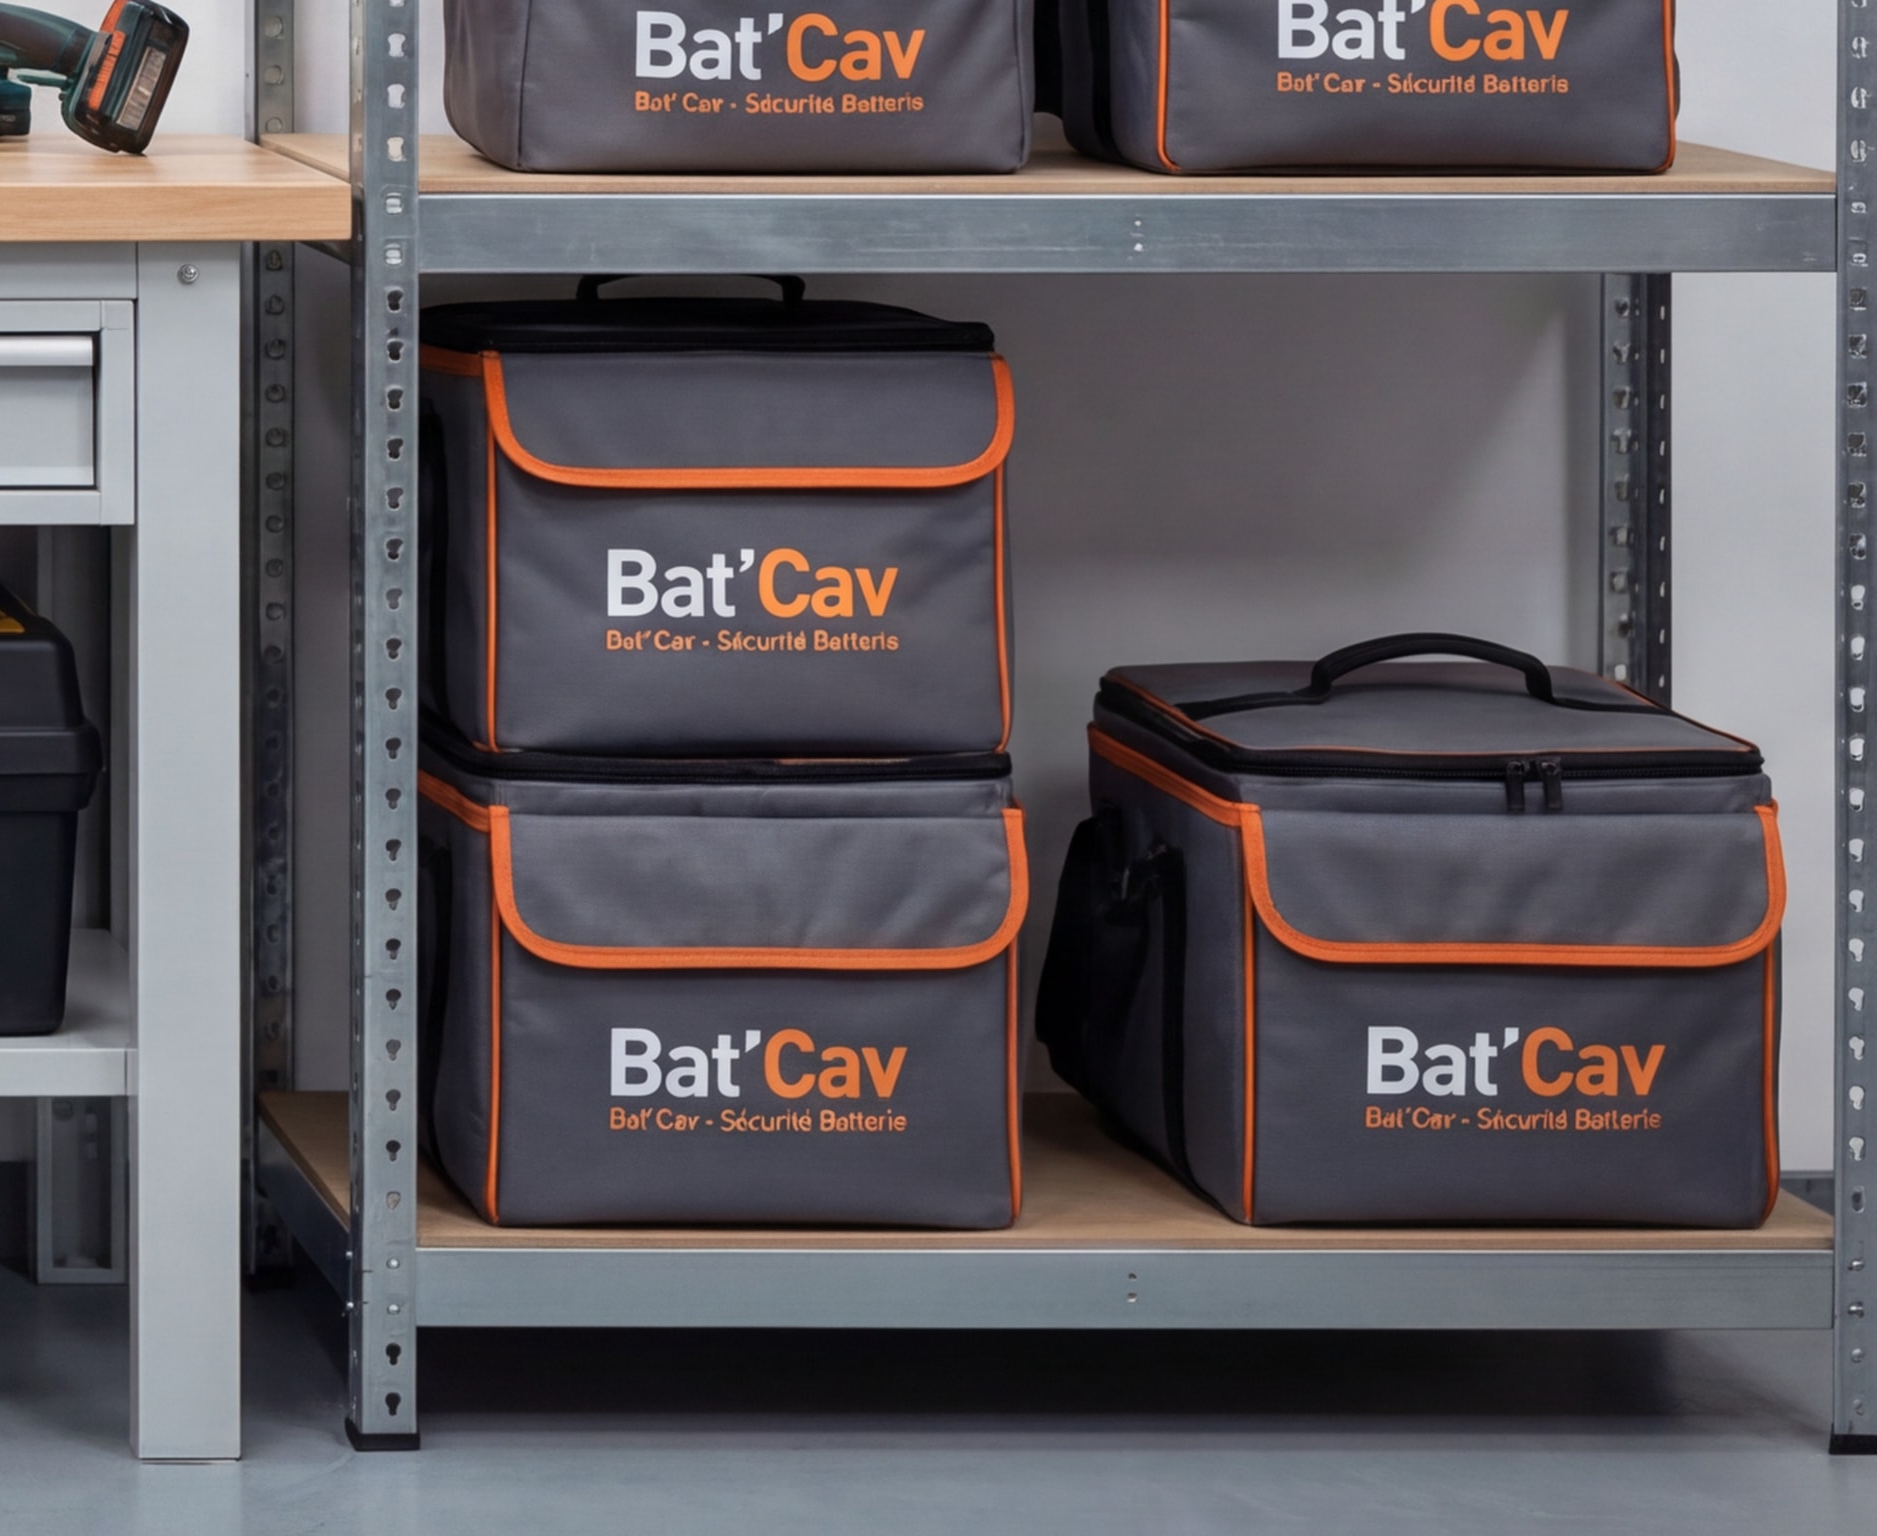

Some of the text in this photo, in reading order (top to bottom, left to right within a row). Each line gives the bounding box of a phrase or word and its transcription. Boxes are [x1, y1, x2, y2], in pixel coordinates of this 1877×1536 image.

[636, 11, 925, 82] Bat'Cav
[608, 548, 898, 618] Bat'Cav
[611, 1028, 907, 1099] Bat'Cav
[1368, 1026, 1665, 1097] Bat'Cav
